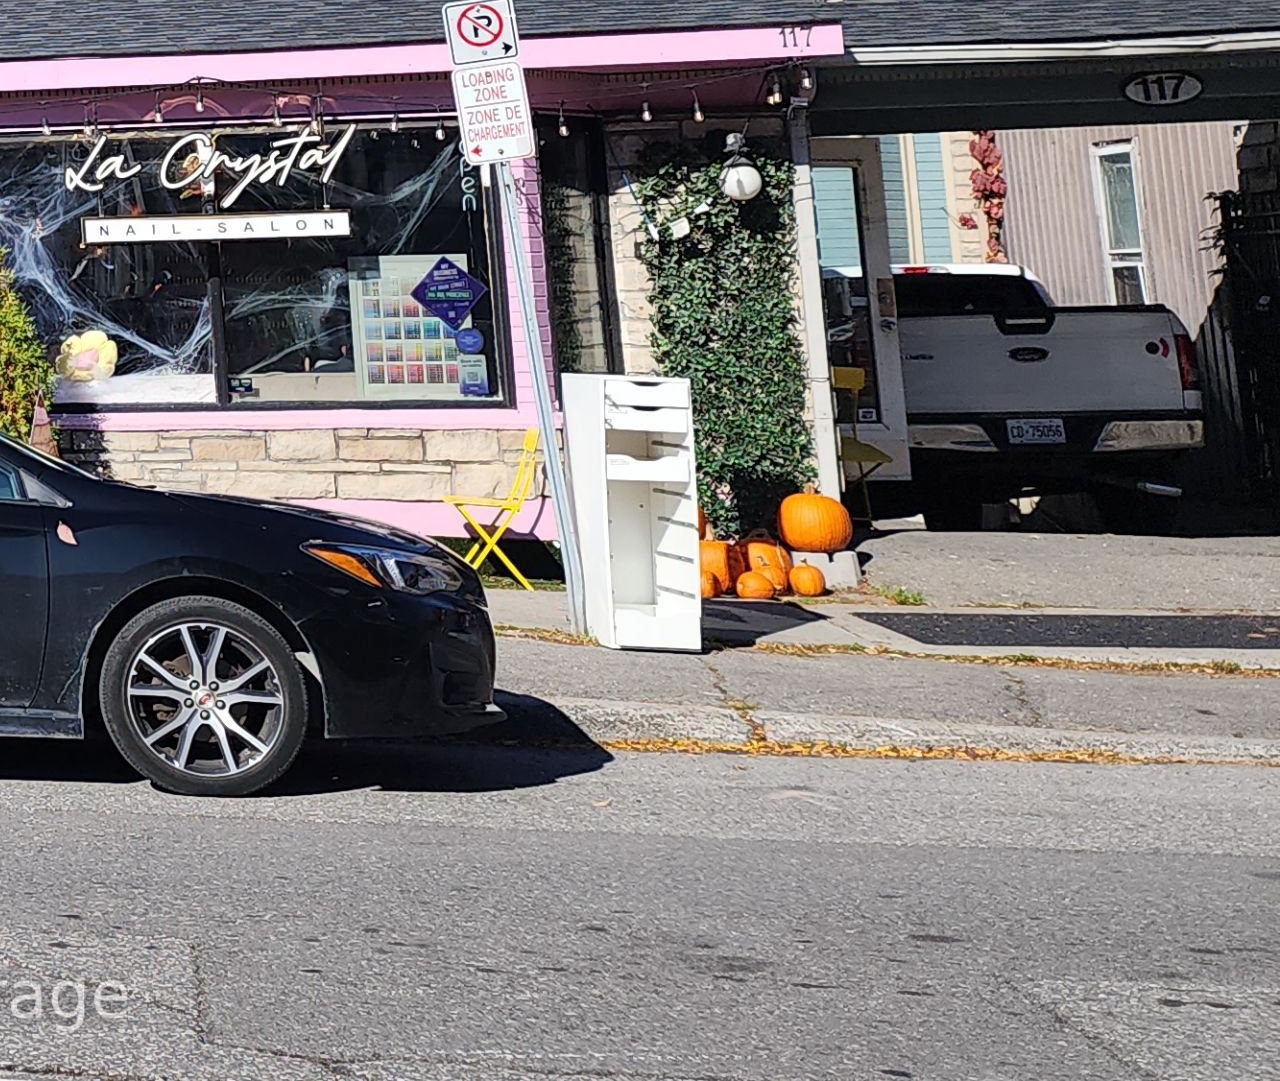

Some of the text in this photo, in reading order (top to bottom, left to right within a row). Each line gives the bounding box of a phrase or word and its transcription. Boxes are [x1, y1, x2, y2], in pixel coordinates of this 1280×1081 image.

[778, 25, 813, 48] 117
[461, 68, 515, 88] LOADING
[1134, 76, 1186, 101] 117
[474, 85, 508, 103] ZONE
[467, 105, 523, 126] ZONE DE
[467, 121, 526, 143] CHARGEMENT
[64, 123, 359, 209] La Crystal
